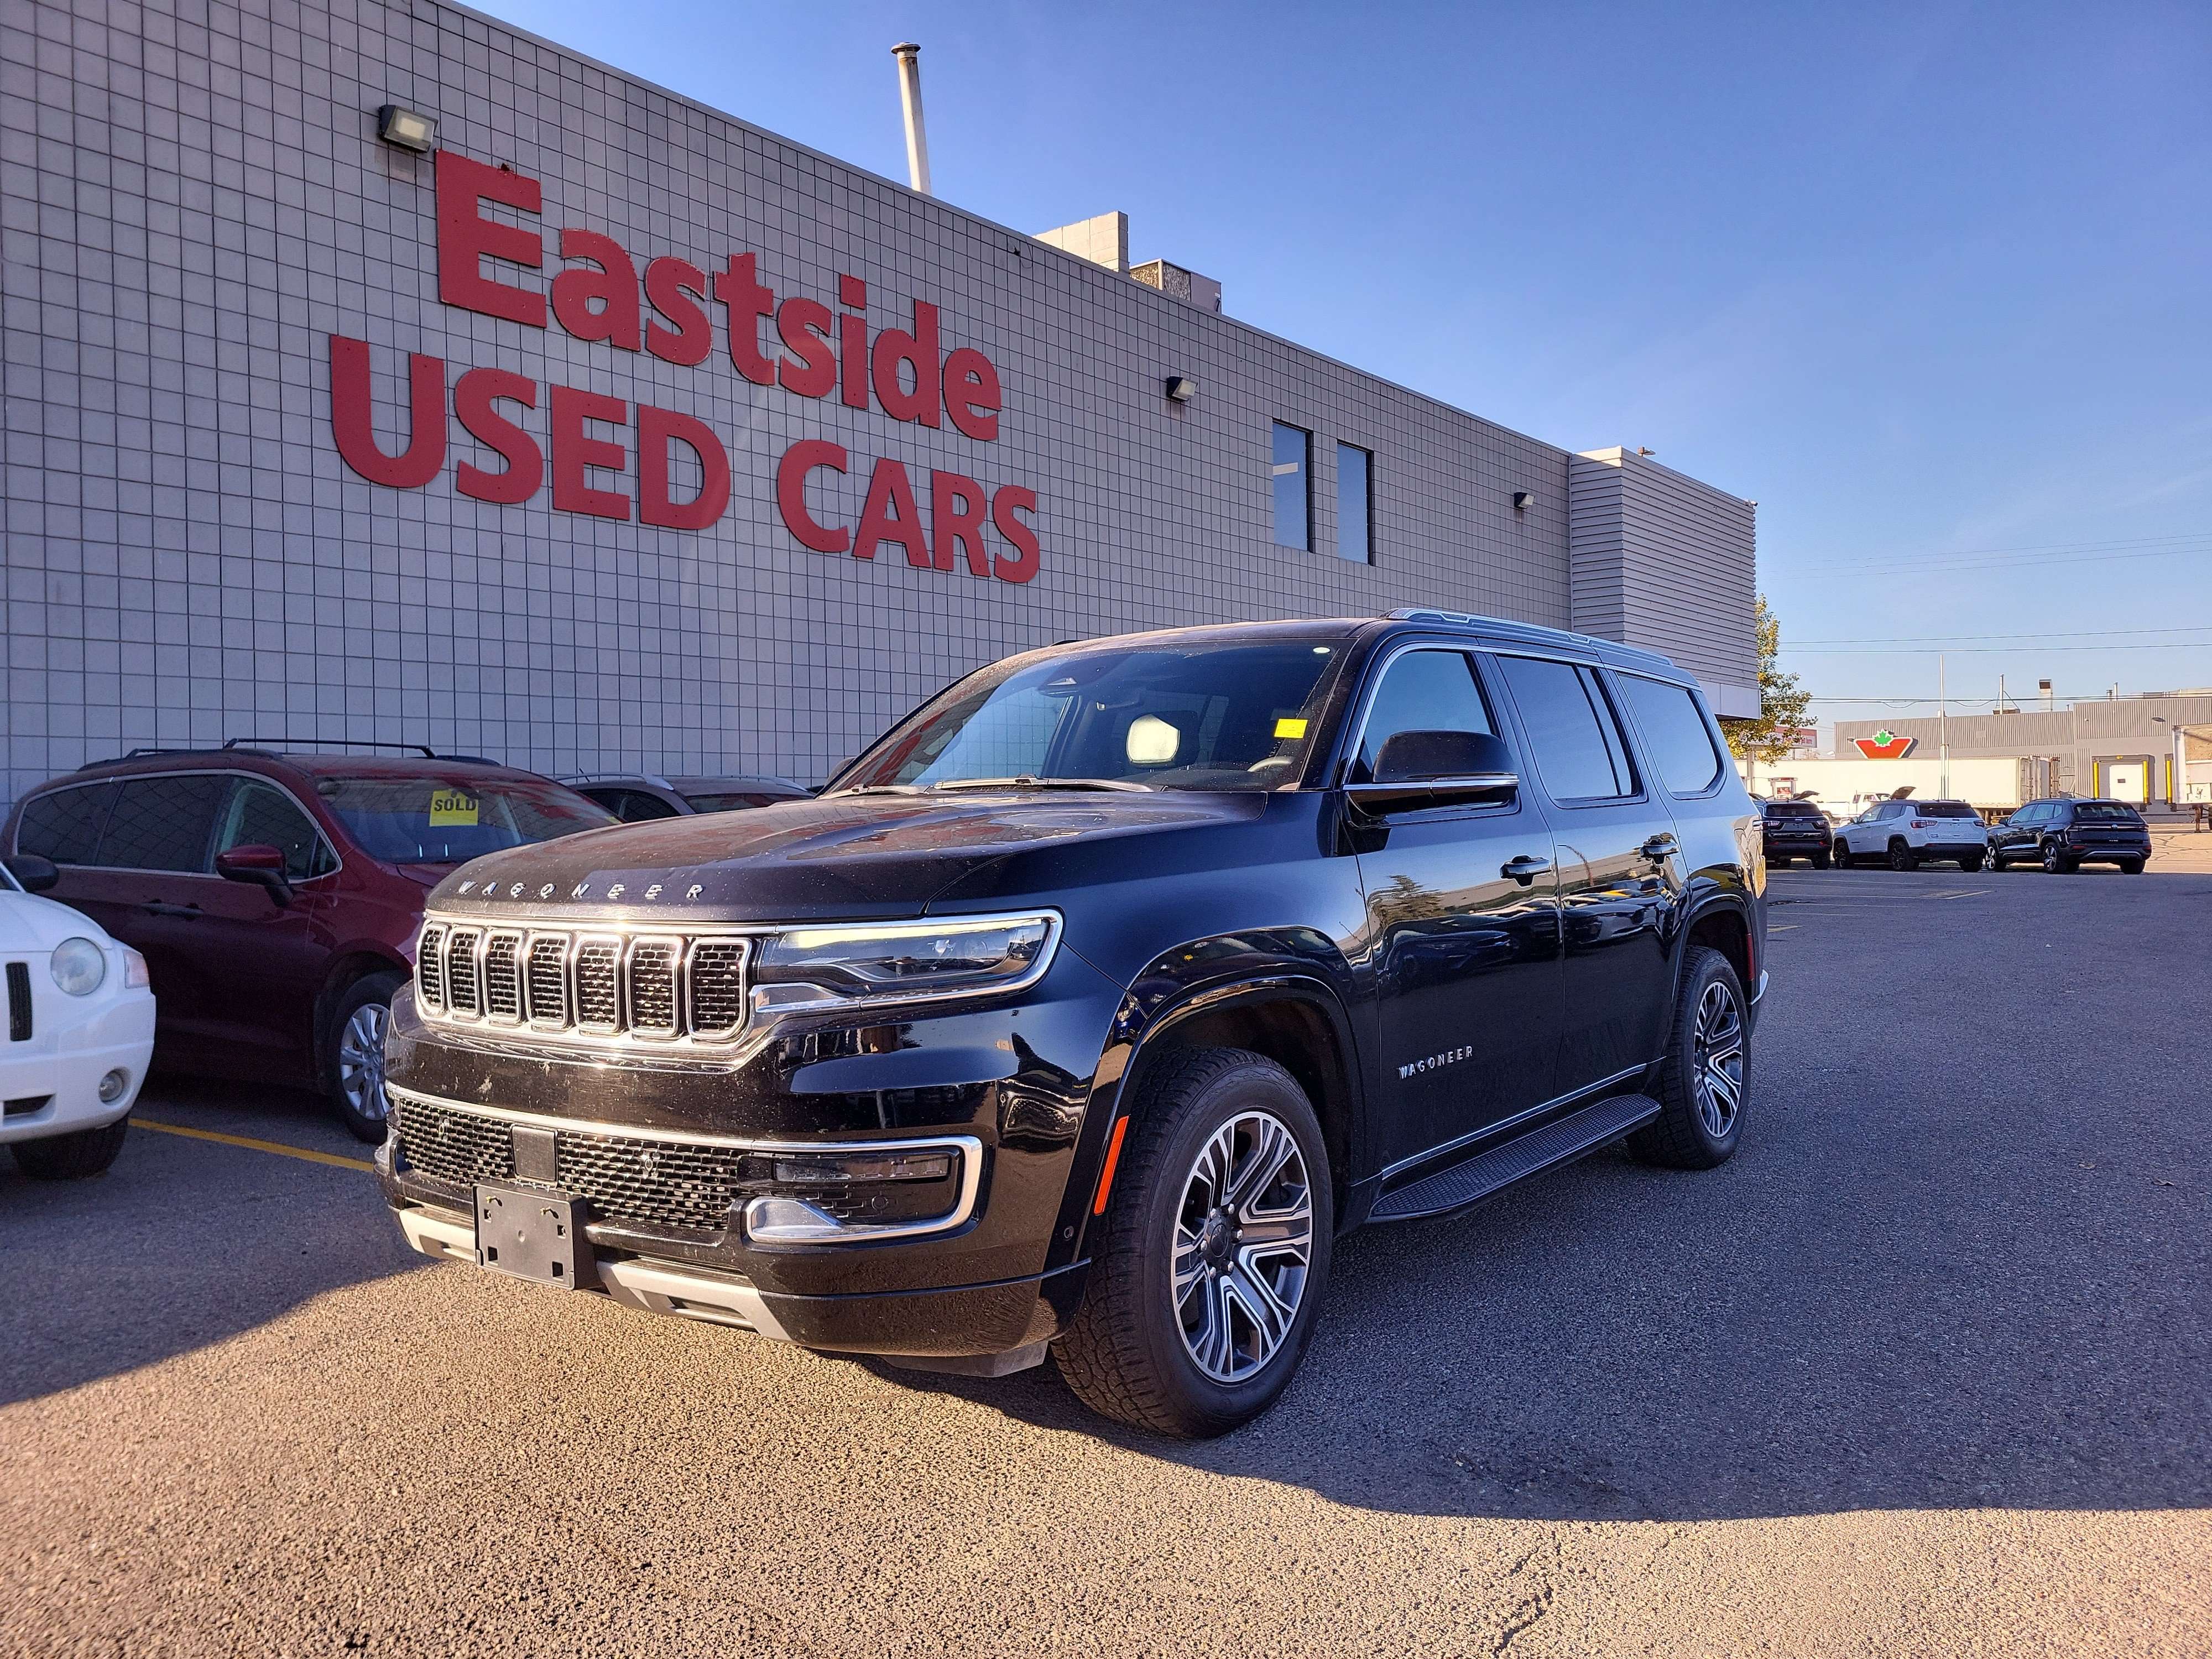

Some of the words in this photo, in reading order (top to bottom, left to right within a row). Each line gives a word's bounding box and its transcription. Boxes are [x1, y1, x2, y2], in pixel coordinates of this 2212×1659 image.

[435, 149, 1002, 441] Eastside
[330, 335, 731, 530] USED
[777, 439, 1040, 583] CARS
[434, 799, 476, 811] SOLD
[458, 881, 704, 900] WAGONEER
[1397, 1045, 1473, 1079] WAGONEER
